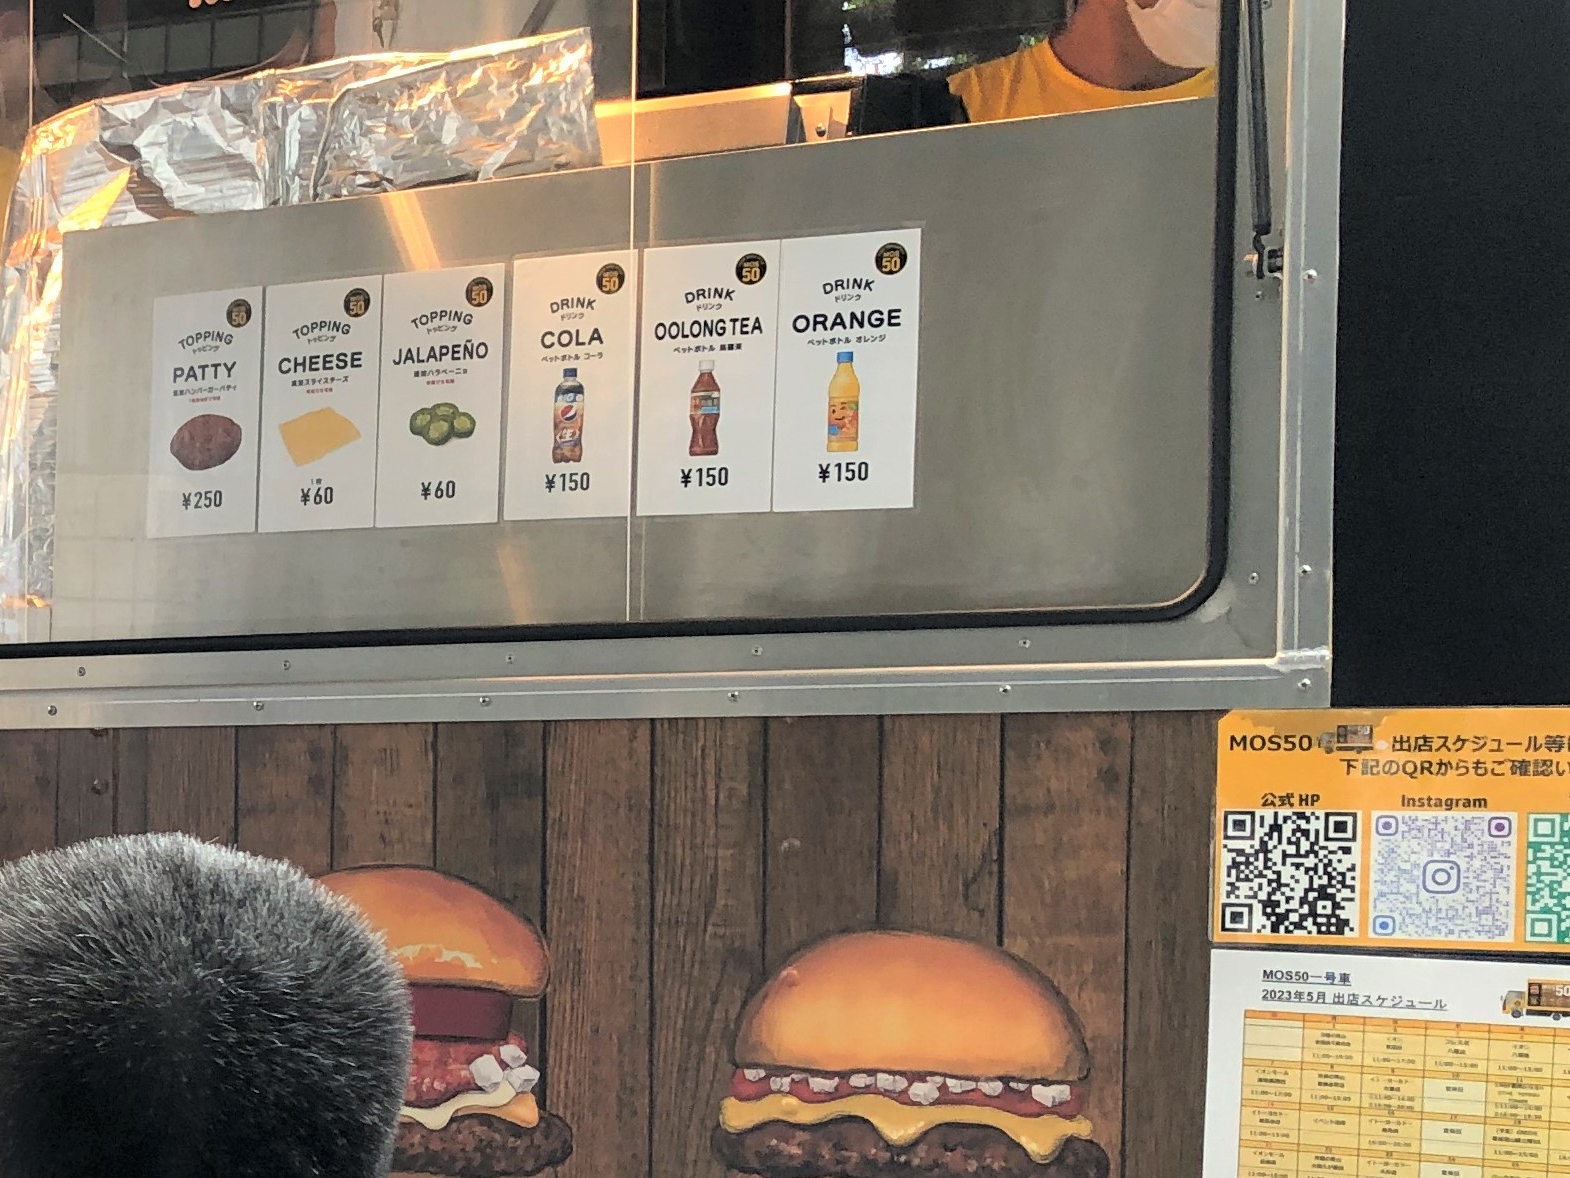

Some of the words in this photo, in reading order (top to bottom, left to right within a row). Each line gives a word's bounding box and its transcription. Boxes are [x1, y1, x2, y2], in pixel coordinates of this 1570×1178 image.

[882, 257, 900, 272] 50
[602, 277, 619, 291] 50
[742, 268, 760, 282] 50
[685, 287, 735, 304] DRINK
[823, 278, 875, 294] DRINK
[550, 297, 596, 314] DRINK
[292, 320, 351, 339] TOPPING
[411, 310, 474, 329] TOPPING
[655, 319, 726, 340] OOLONG
[729, 317, 763, 335] TEA
[792, 309, 902, 333] ORANGE
[178, 330, 233, 350] TOPPING
[540, 327, 604, 349] COLA
[392, 339, 489, 365] JALAPEÑO
[173, 361, 237, 384] PATTY
[278, 351, 363, 375] CHEESE
[545, 472, 590, 493] ¥150
[680, 467, 729, 488] ¥150
[819, 462, 869, 483] ¥150
[182, 490, 223, 510] ¥250
[300, 486, 334, 506] ¥60
[421, 480, 456, 500] ¥60
[1230, 734, 1312, 752] MOS50
[1261, 793, 1295, 807] 公式
[1299, 794, 1320, 806] HP
[1401, 794, 1487, 810] Instagram
[1262, 989, 1326, 1003] 2023年5月
[1333, 992, 1448, 1009] 出店スケジュール
